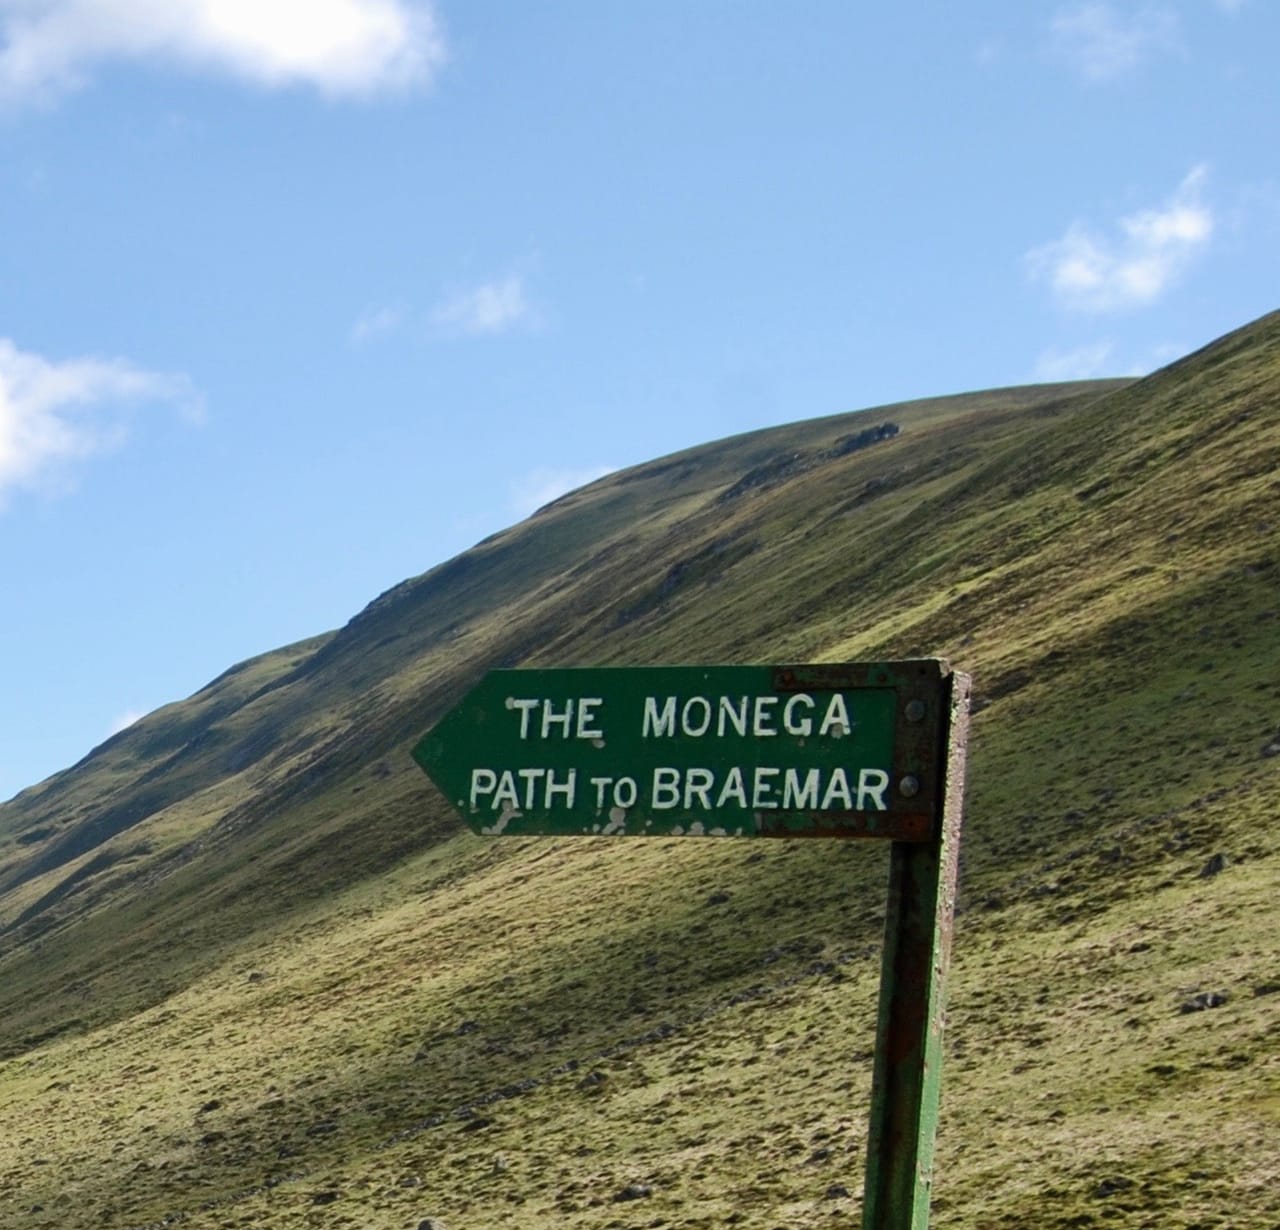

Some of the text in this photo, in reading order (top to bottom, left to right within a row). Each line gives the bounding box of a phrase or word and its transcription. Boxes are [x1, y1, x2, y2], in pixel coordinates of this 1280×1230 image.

[513, 693, 851, 739] THE MONEGA
[470, 767, 890, 810] PATH TO BRAEMAR
